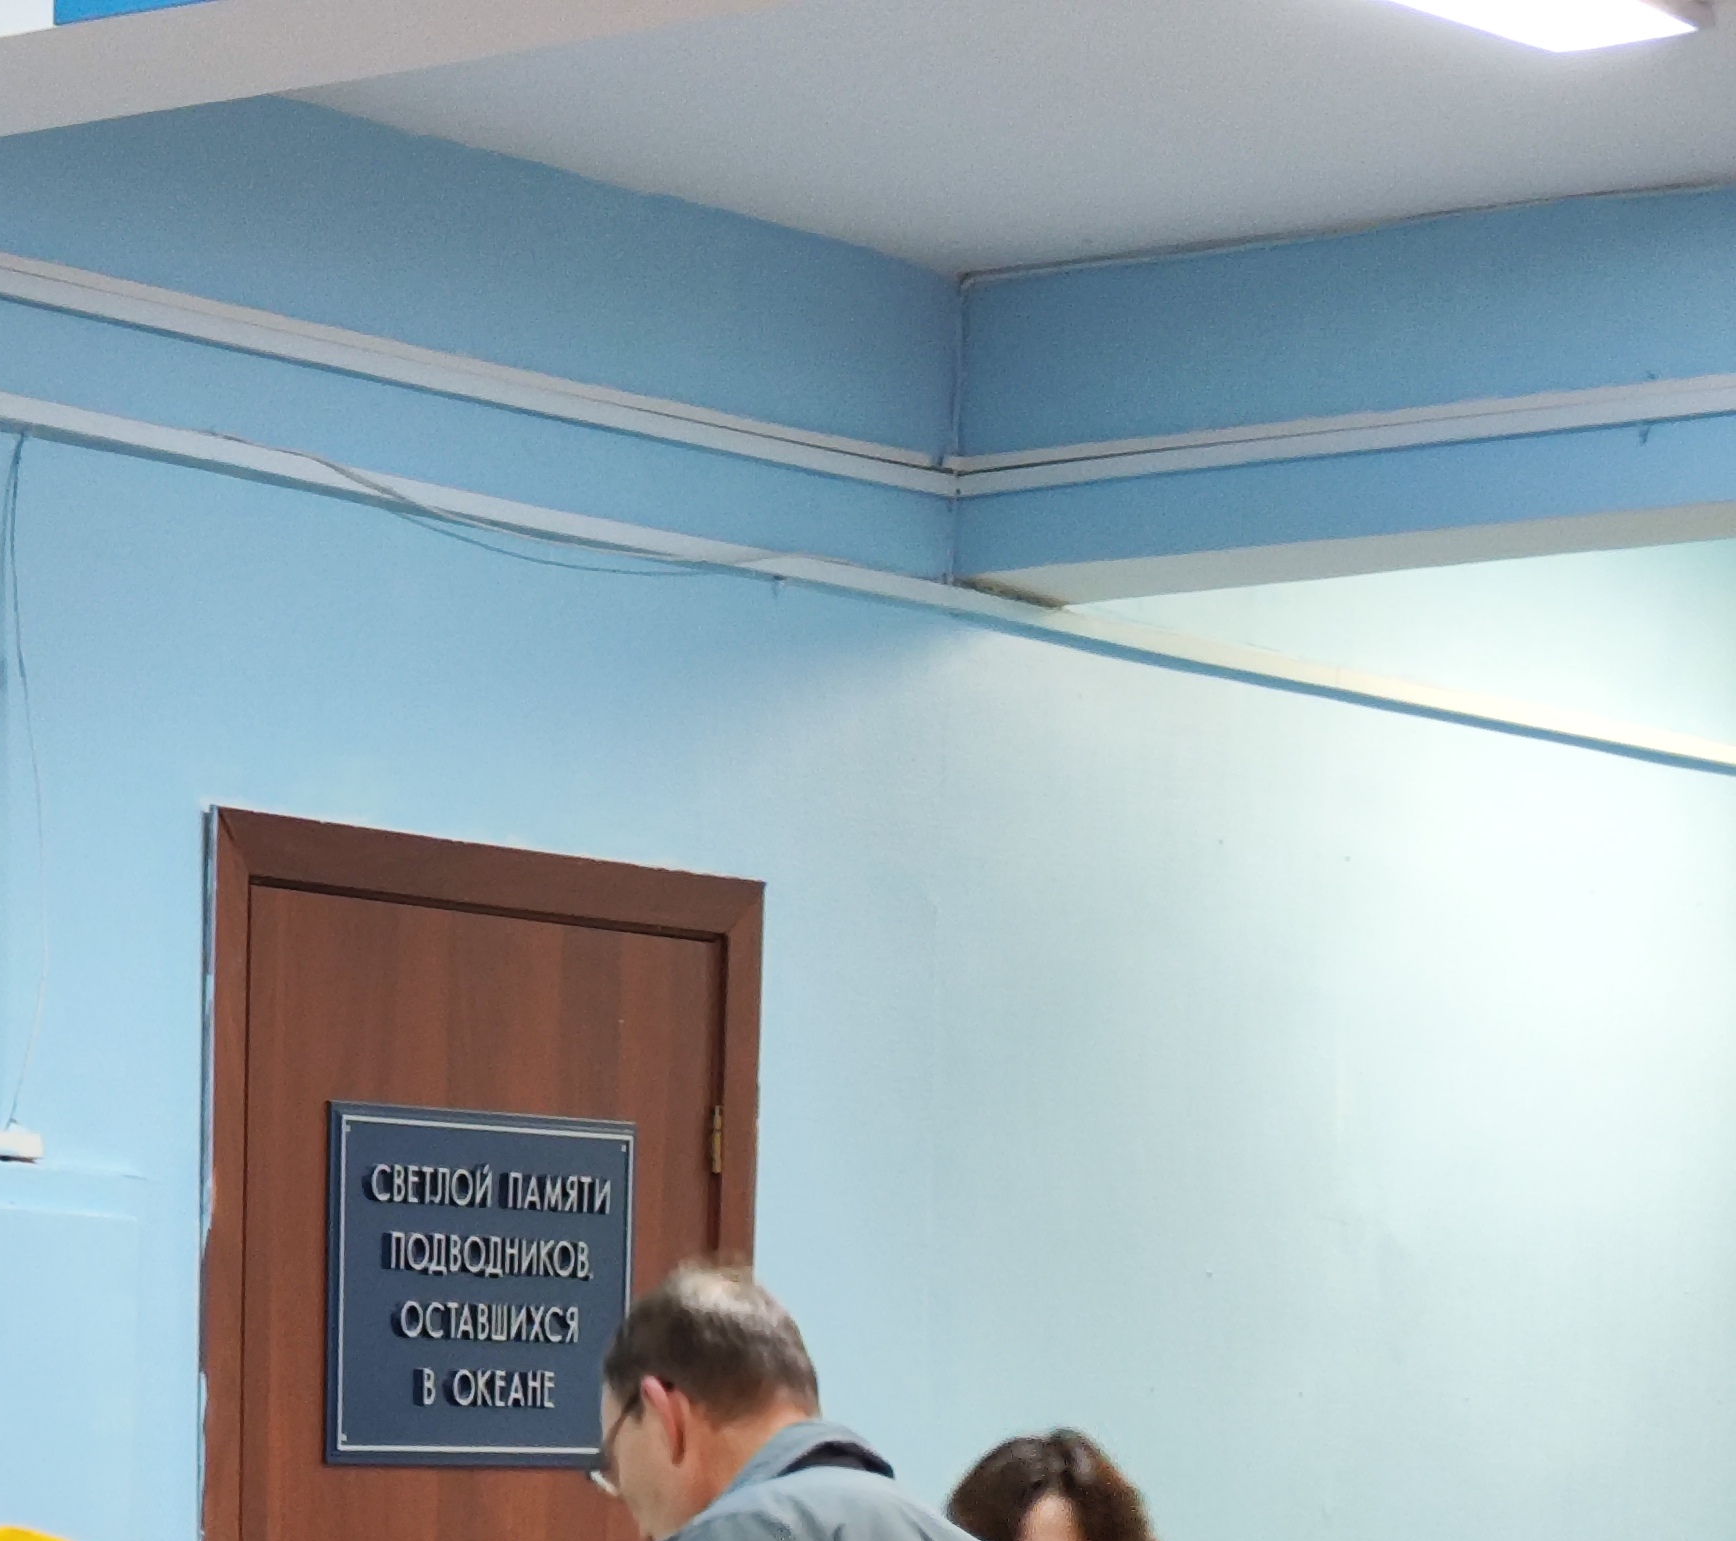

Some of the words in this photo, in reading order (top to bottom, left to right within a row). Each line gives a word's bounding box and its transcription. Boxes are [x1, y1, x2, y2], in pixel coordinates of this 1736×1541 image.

[370, 1163, 493, 1208] СВЕТЛОЙ
[507, 1171, 611, 1215] ПАМЯТИ
[400, 1301, 580, 1343] ОСТАВШИХСЯ
[422, 1367, 436, 1405] В
[451, 1368, 556, 1408] ОКЕАНЕ
